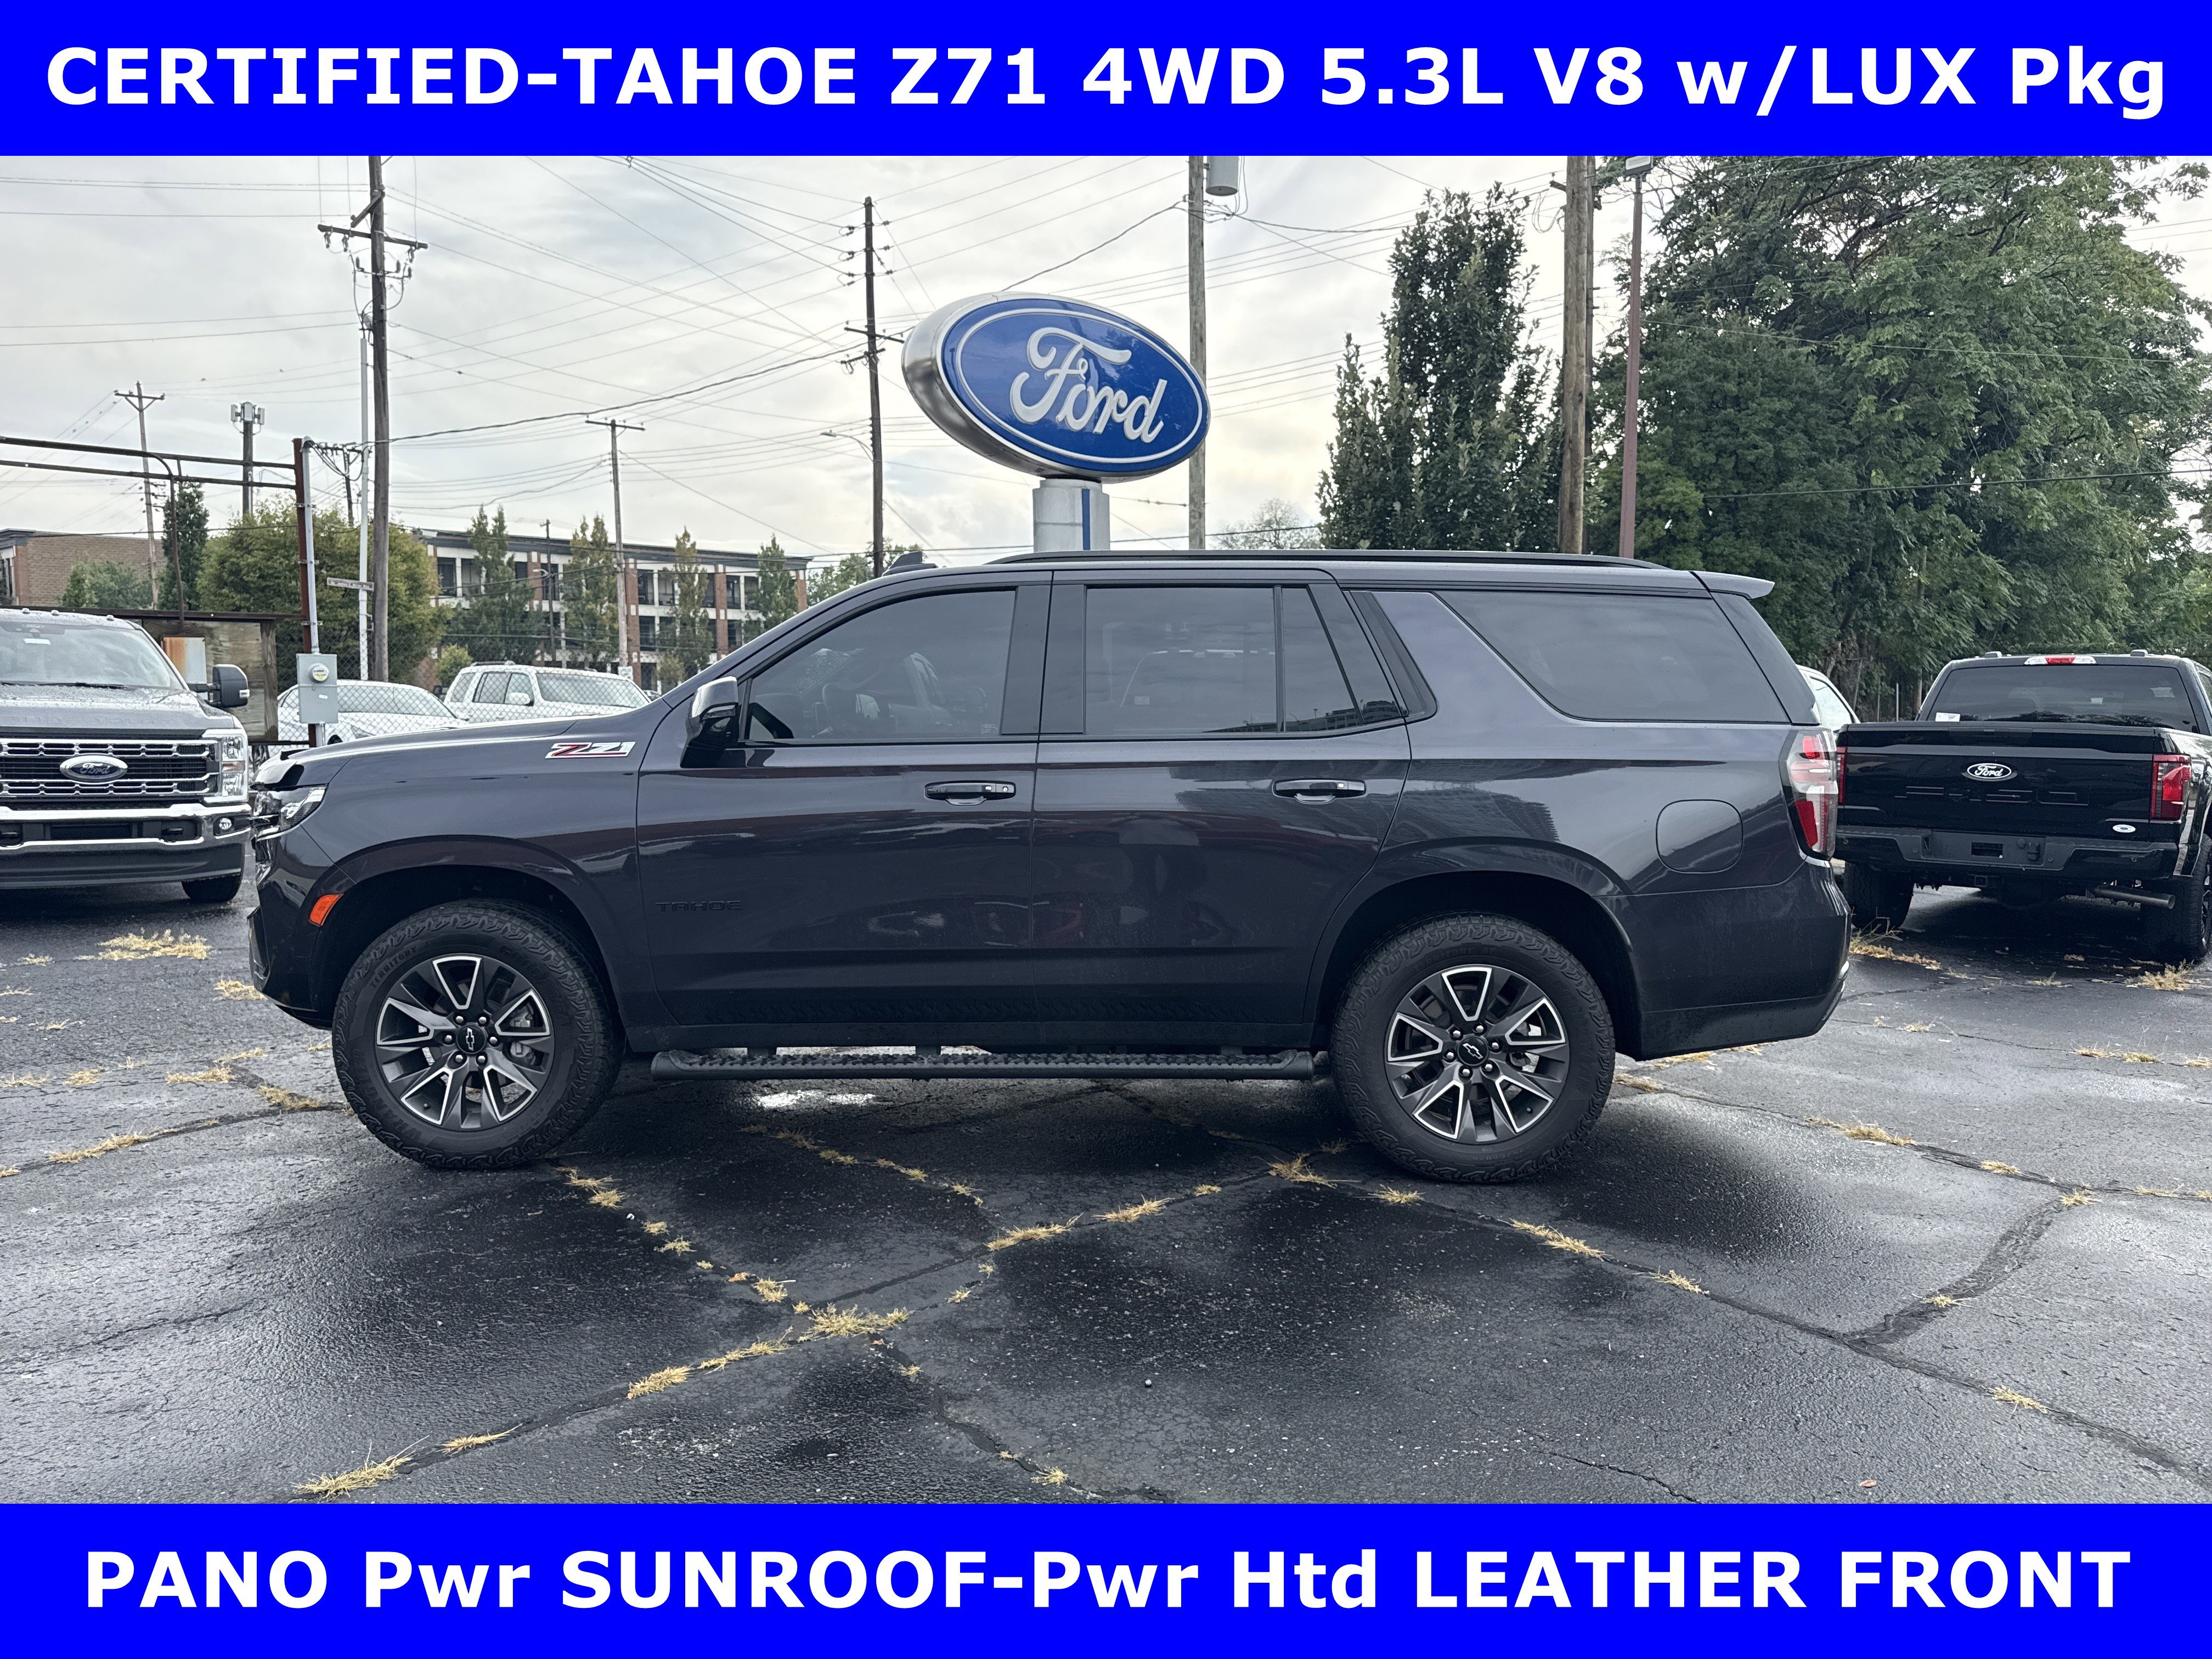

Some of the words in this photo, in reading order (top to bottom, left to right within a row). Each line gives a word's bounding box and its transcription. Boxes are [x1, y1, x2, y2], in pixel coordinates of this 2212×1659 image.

[1010, 326, 1167, 444] Ford
[545, 742, 635, 759] Z71
[80, 763, 110, 774] Ford
[1974, 765, 2004, 776] Ford
[654, 900, 742, 912] TAHOE
